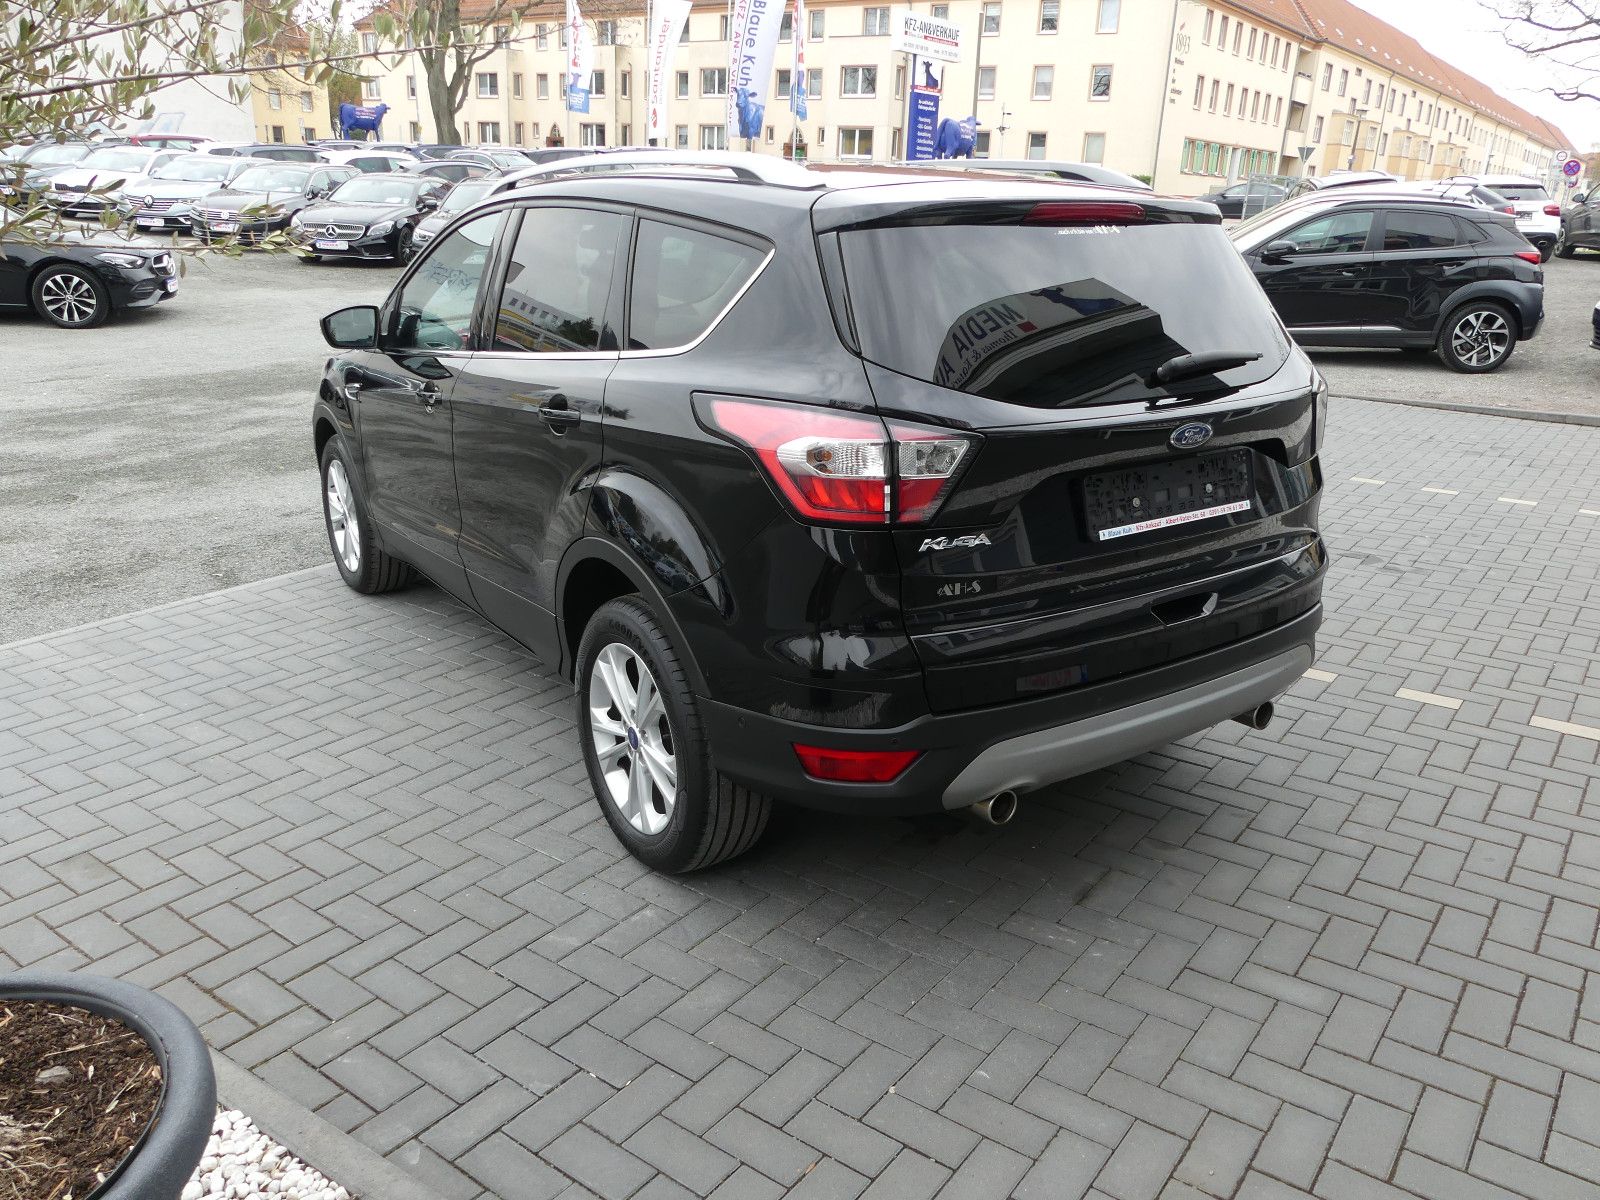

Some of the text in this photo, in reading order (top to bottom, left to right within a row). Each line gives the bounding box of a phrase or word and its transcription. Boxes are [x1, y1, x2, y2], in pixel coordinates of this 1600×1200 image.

[652, 17, 671, 104] Santander
[738, 0, 767, 87] Blaue Kuh
[918, 533, 992, 552] KUGA
